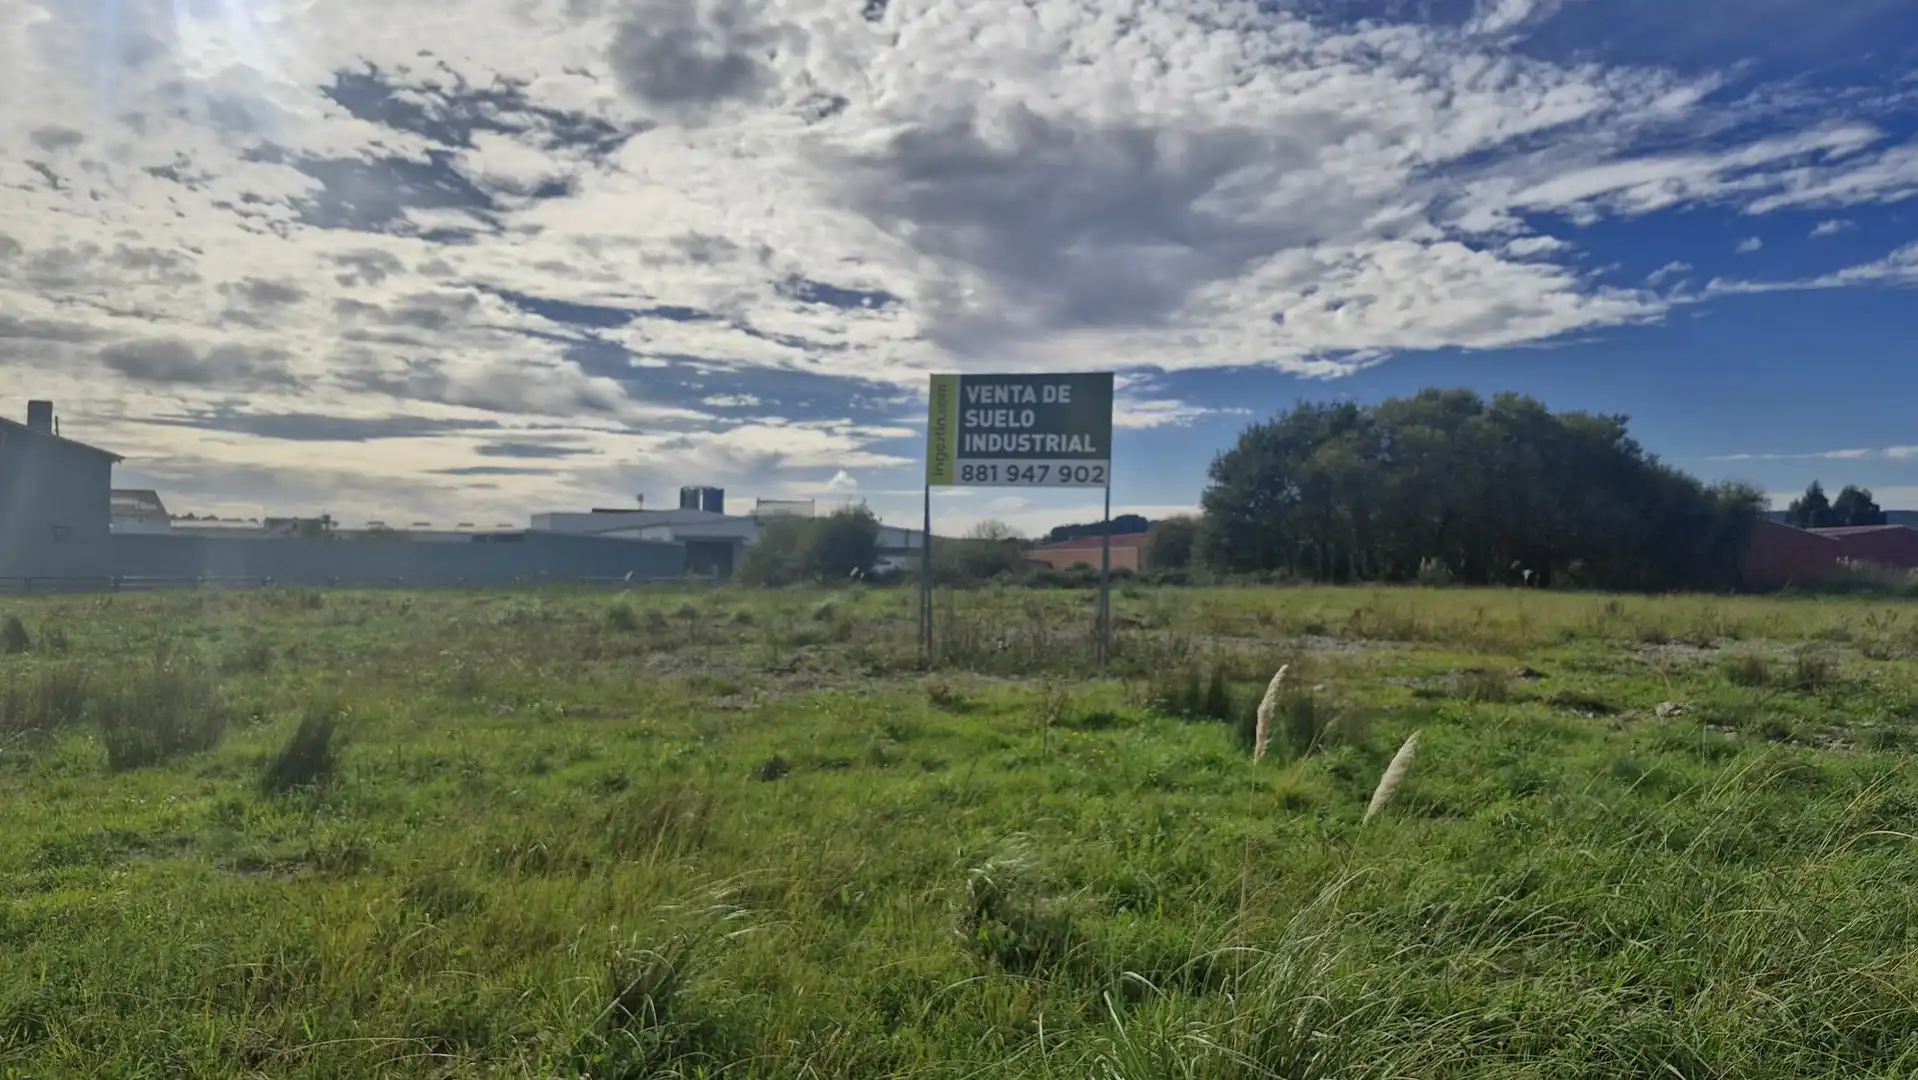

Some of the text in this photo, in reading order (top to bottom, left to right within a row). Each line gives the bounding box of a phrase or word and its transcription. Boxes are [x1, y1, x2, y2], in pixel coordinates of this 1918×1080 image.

[966, 385, 1071, 403] VENTA DE
[964, 409, 1035, 427] SUELO
[964, 434, 1096, 452] INDUSTRIAL
[962, 464, 1105, 483] 881 947 902
